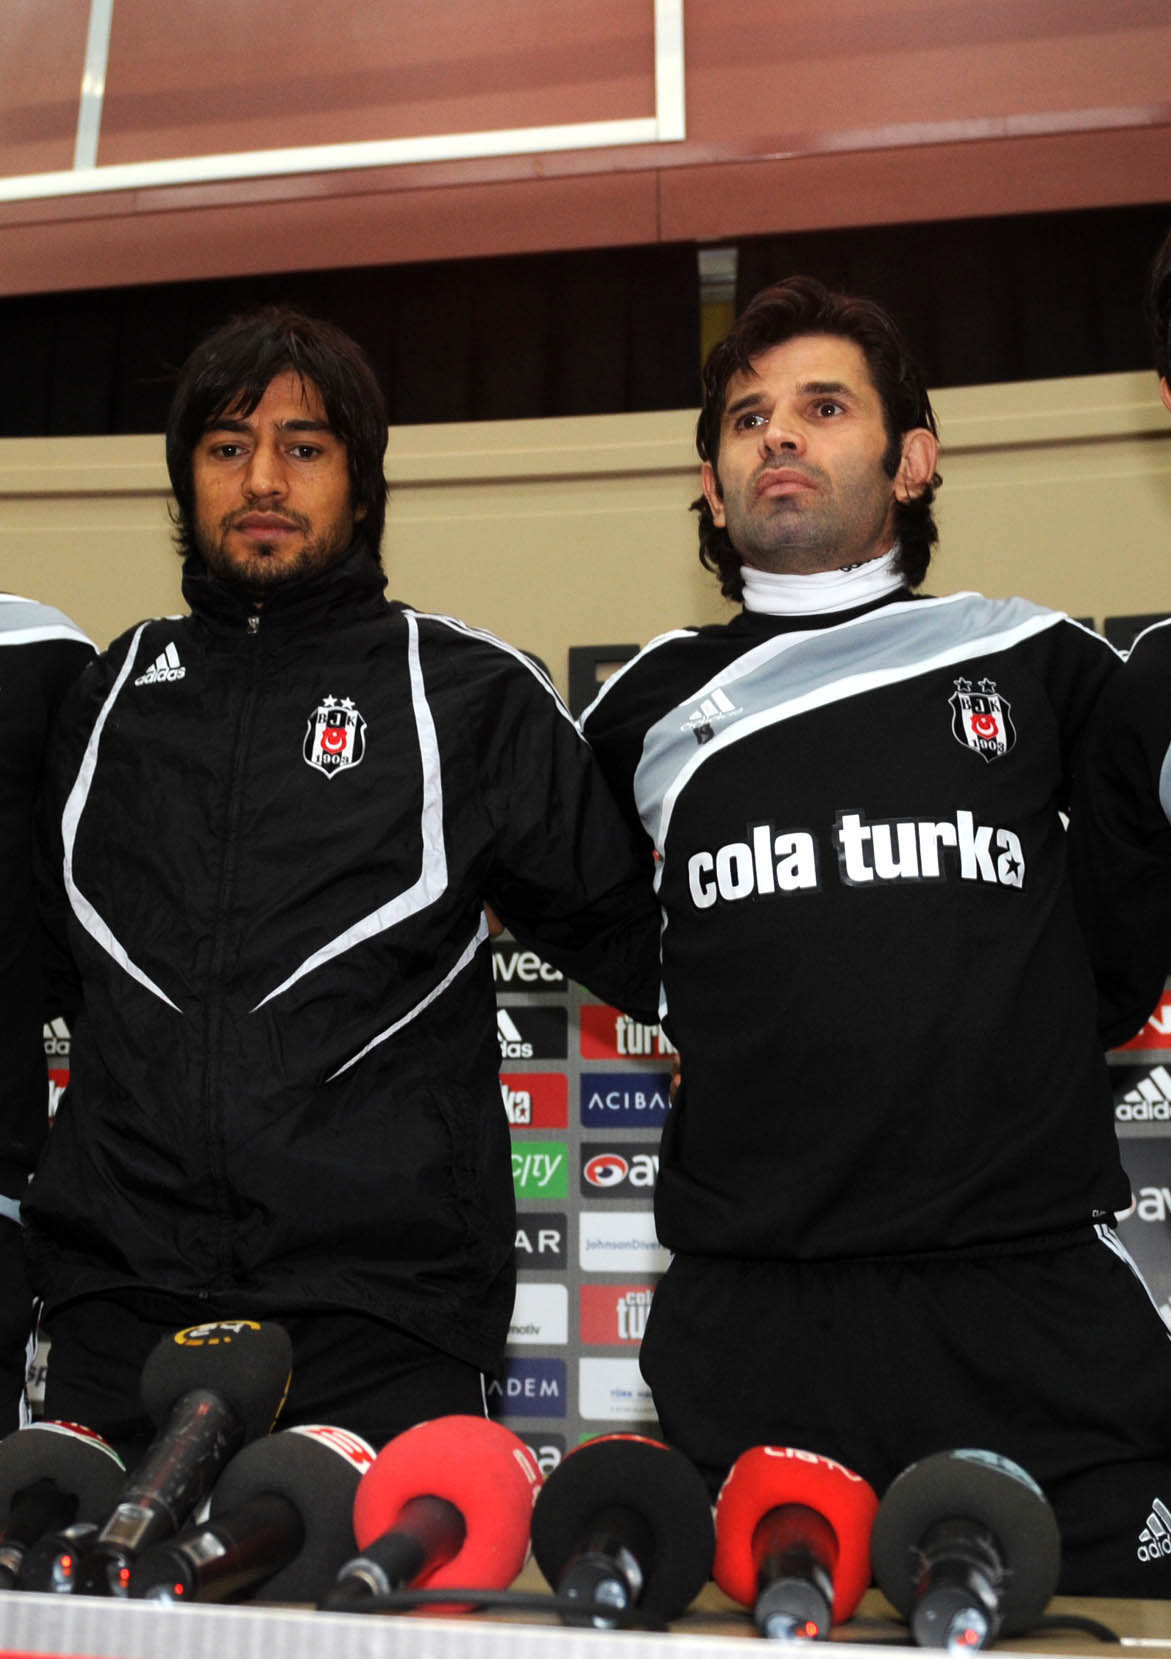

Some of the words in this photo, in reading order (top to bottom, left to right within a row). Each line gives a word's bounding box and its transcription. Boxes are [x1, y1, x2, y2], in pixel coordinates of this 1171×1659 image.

[134, 666, 187, 687] adidas
[961, 697, 1001, 713] BJK
[317, 712, 358, 728] BJK
[970, 739, 1006, 753] 1903
[315, 753, 349, 766] 1903
[688, 825, 818, 909] cola
[838, 809, 1026, 889] turka
[493, 952, 564, 982] vea
[588, 1091, 673, 1110] ACIBA
